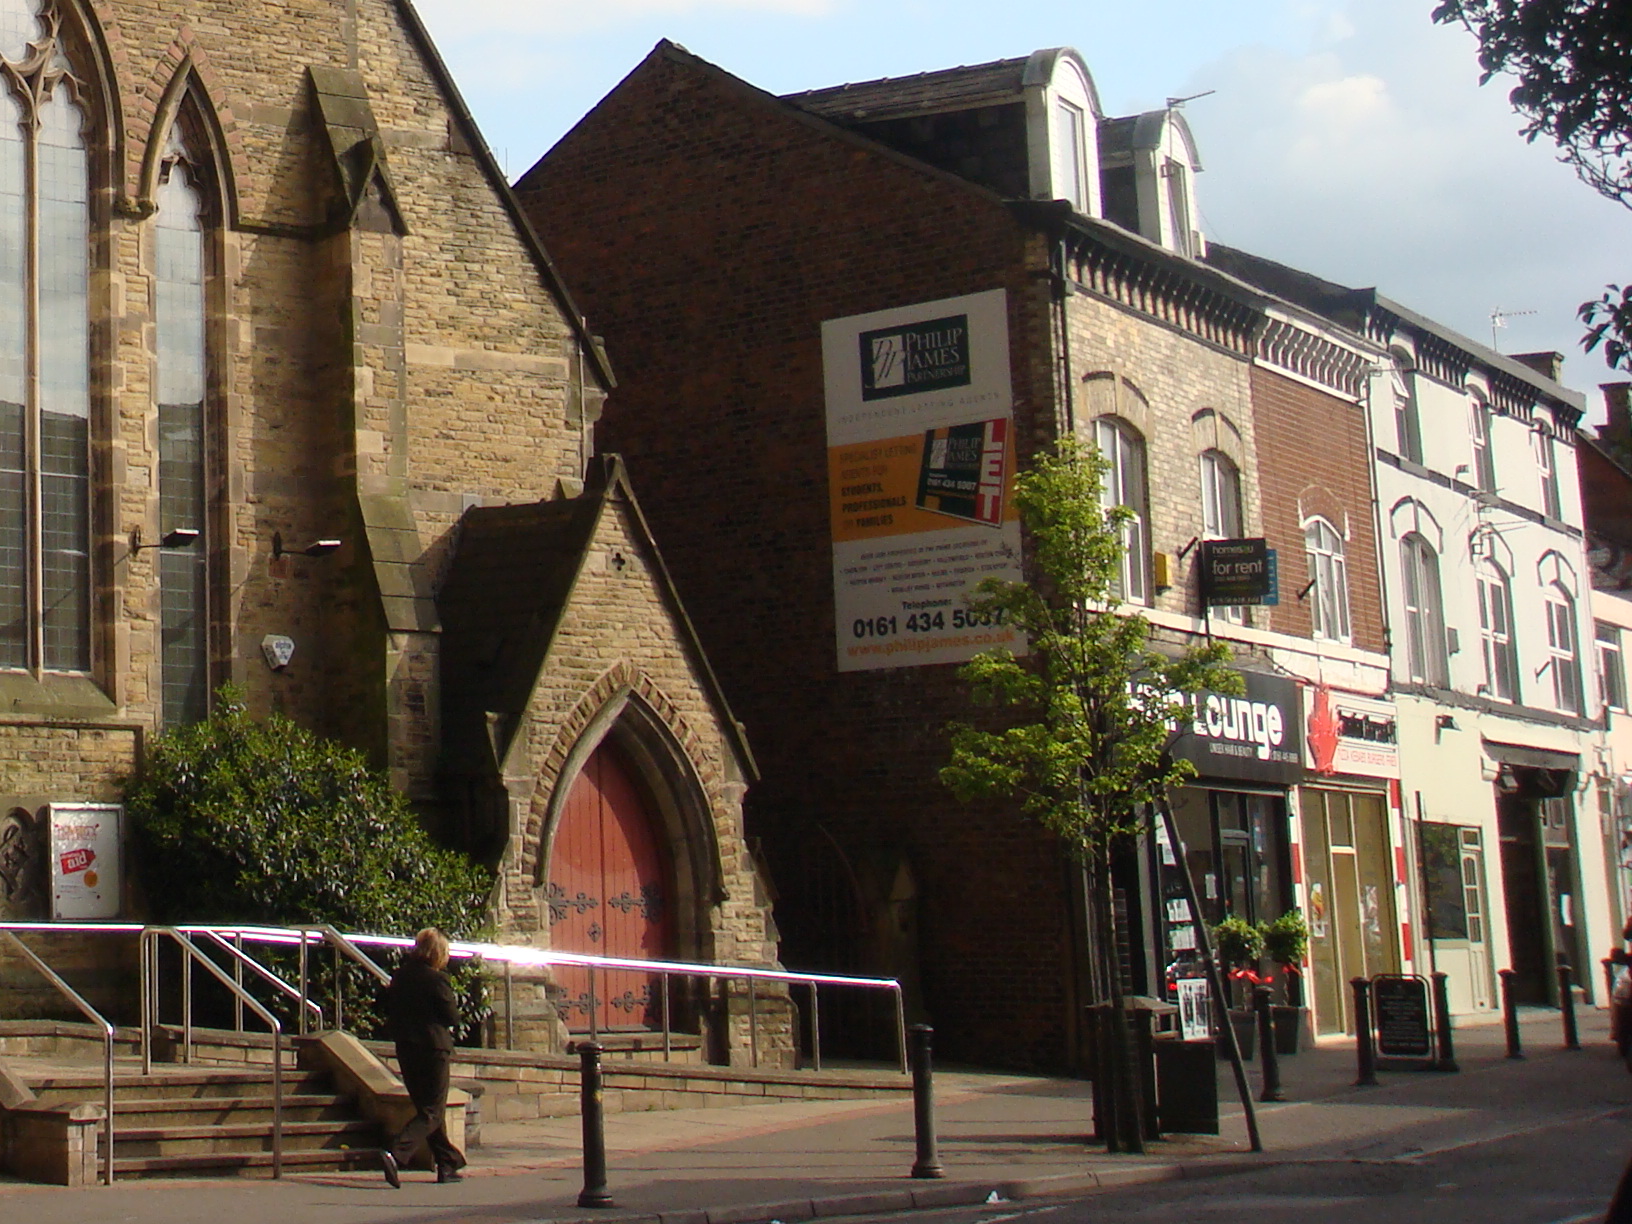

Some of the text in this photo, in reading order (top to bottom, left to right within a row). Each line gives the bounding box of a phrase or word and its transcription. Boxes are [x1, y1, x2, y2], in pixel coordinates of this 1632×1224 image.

[906, 328, 963, 351] PHILIP
[906, 346, 960, 370] JAMES
[979, 422, 1003, 519] LET
[1212, 559, 1263, 575] for rent
[853, 615, 897, 638] 0161
[906, 611, 944, 633] 434
[1191, 693, 1283, 761] Lounge
[68, 851, 88, 869] aid
